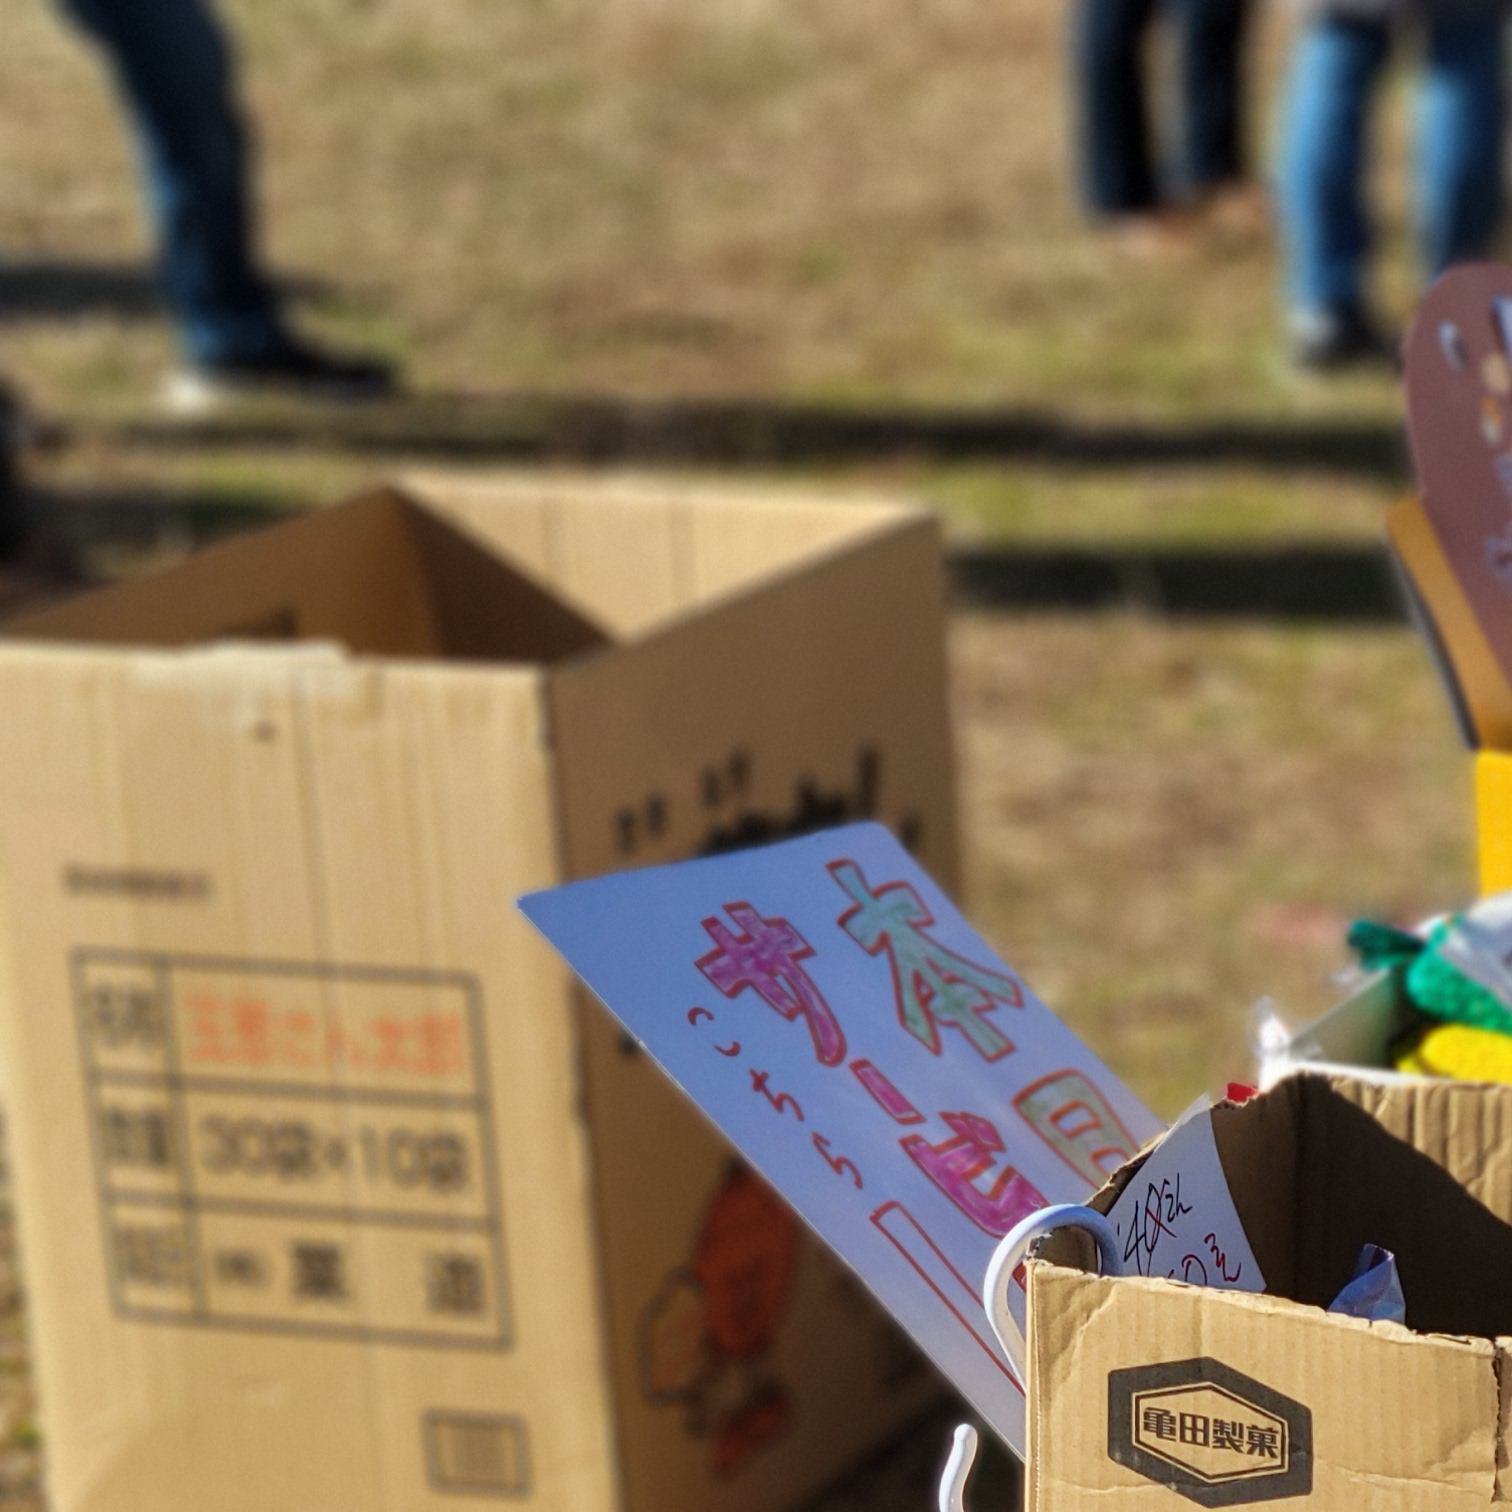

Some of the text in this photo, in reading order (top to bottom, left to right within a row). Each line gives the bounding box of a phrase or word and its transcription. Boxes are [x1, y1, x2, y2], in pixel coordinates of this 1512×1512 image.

[687, 1006, 864, 1190] こちら
[1141, 1404, 1286, 1463] 亀田製菓
